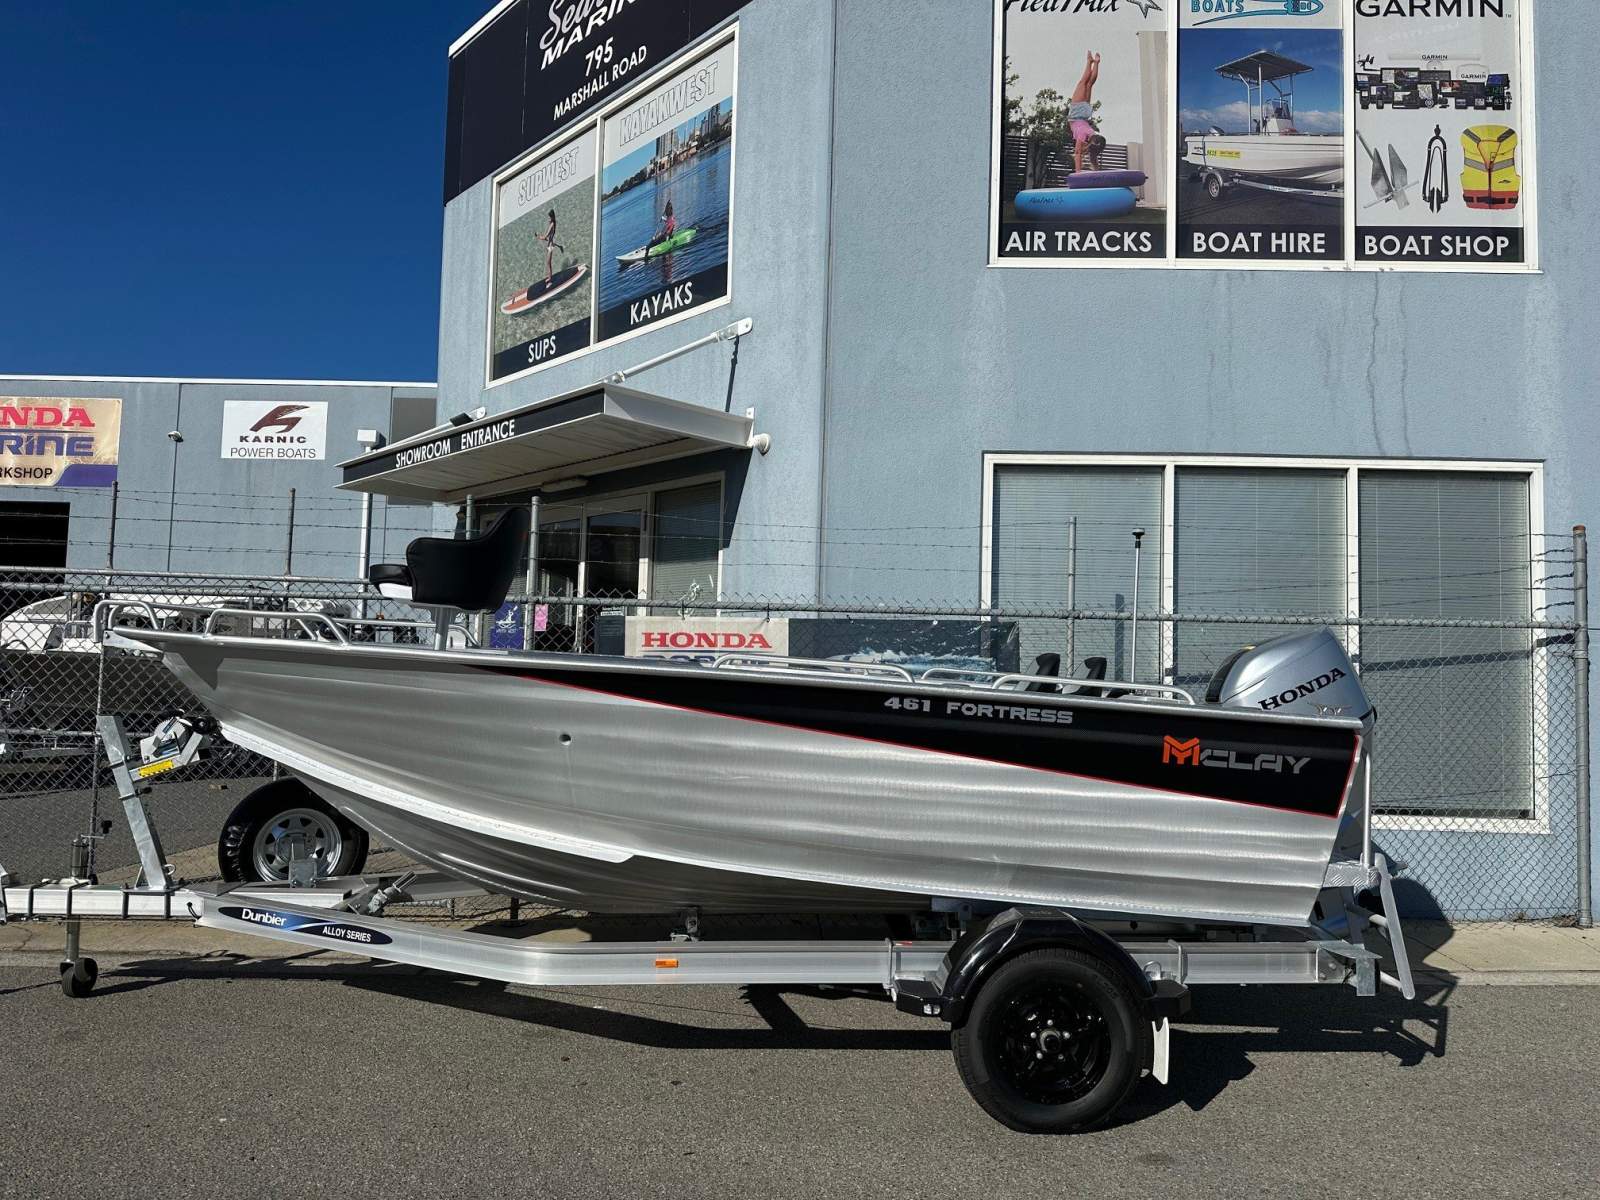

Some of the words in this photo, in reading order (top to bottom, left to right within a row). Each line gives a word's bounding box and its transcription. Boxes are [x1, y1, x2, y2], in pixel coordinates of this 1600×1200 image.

[1191, 0, 1244, 12] BOATS
[1355, 0, 1504, 17] GARMIN
[585, 36, 614, 77] 795
[553, 71, 609, 121] MARSHALL
[612, 45, 647, 83] ROAD
[619, 61, 718, 147] KAYAKWEST
[517, 149, 578, 206] SUPWEST
[1004, 230, 1050, 253] AIR
[1054, 230, 1153, 254] TRACKS
[1192, 231, 1263, 255] BOAT
[1270, 231, 1327, 255] HIRE
[1363, 234, 1434, 257] BOAT
[1440, 234, 1511, 258] SHOP
[629, 280, 693, 325] KAYAKS
[527, 334, 557, 364] SUPS
[239, 435, 307, 444] KARNIC
[395, 437, 451, 469] SHOWROOM
[460, 418, 516, 451] ENTRANCE
[230, 447, 274, 458] POWER
[277, 448, 316, 458] BOATS
[641, 632, 773, 649] HONDA
[1257, 667, 1347, 711] HONDA
[884, 696, 931, 712] 461
[945, 701, 1074, 724] FORTRESS
[241, 908, 287, 927] Dunbier
[322, 925, 346, 939] ALLOY
[346, 930, 372, 943] SERIES
